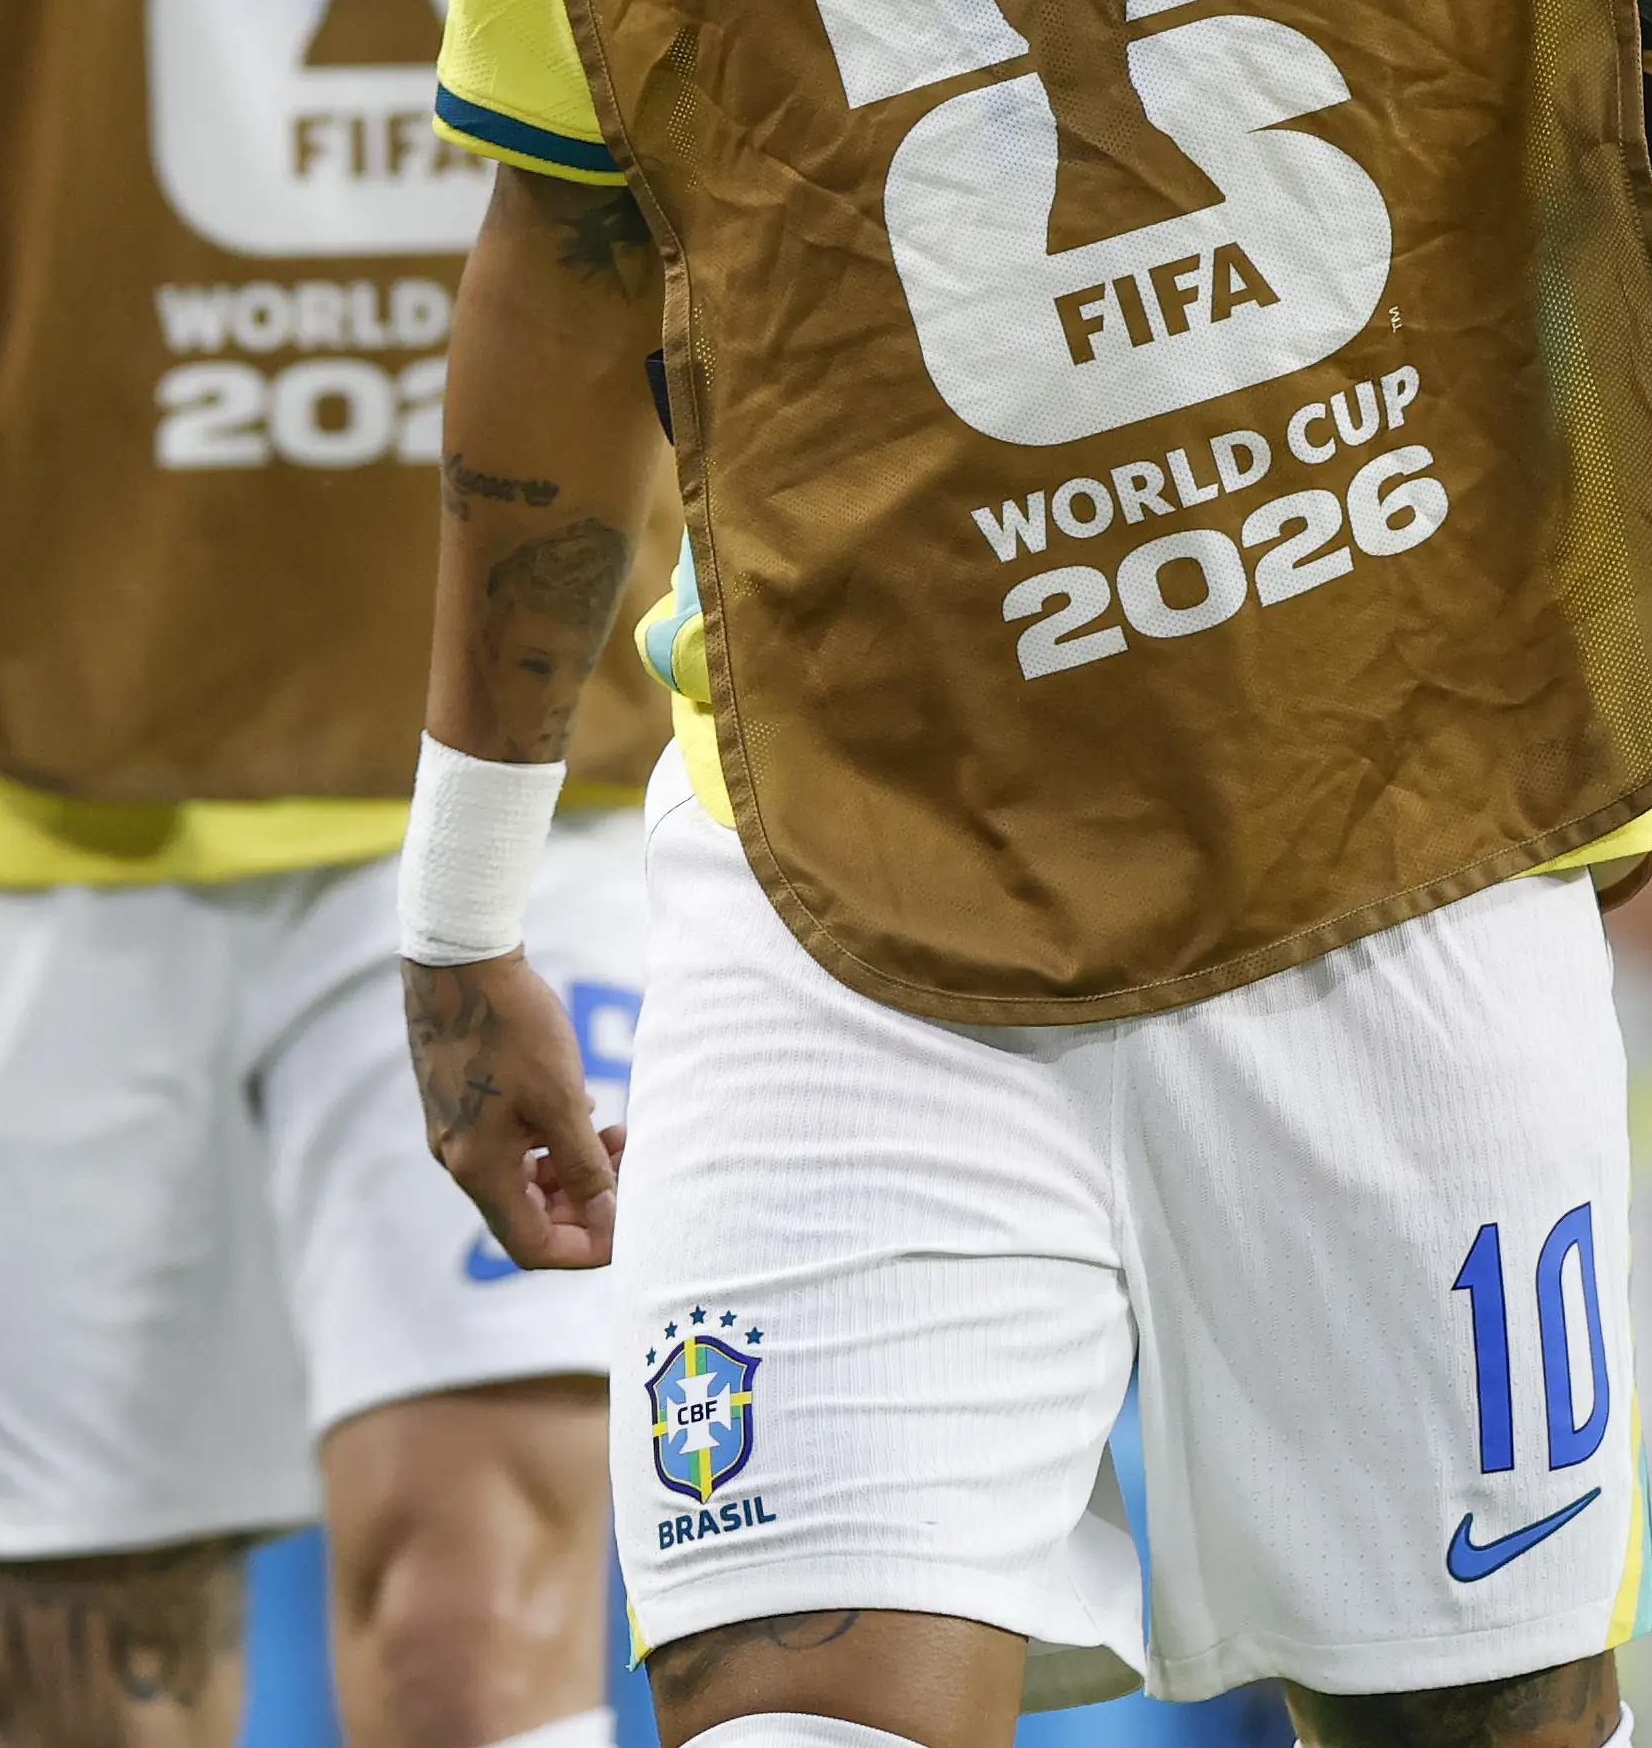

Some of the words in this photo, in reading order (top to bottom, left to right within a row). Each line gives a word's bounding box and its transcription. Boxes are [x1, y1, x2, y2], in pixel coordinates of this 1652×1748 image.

[155, 280, 453, 353] WORLD
[1053, 241, 1280, 366] FIFA
[970, 430, 1273, 563] WORLD
[1286, 364, 1420, 465] CUP
[1001, 445, 1450, 681] 2026
[1451, 1201, 1610, 1474] 10
[677, 1399, 718, 1426] CBF
[657, 1495, 776, 1550] BRASIL
